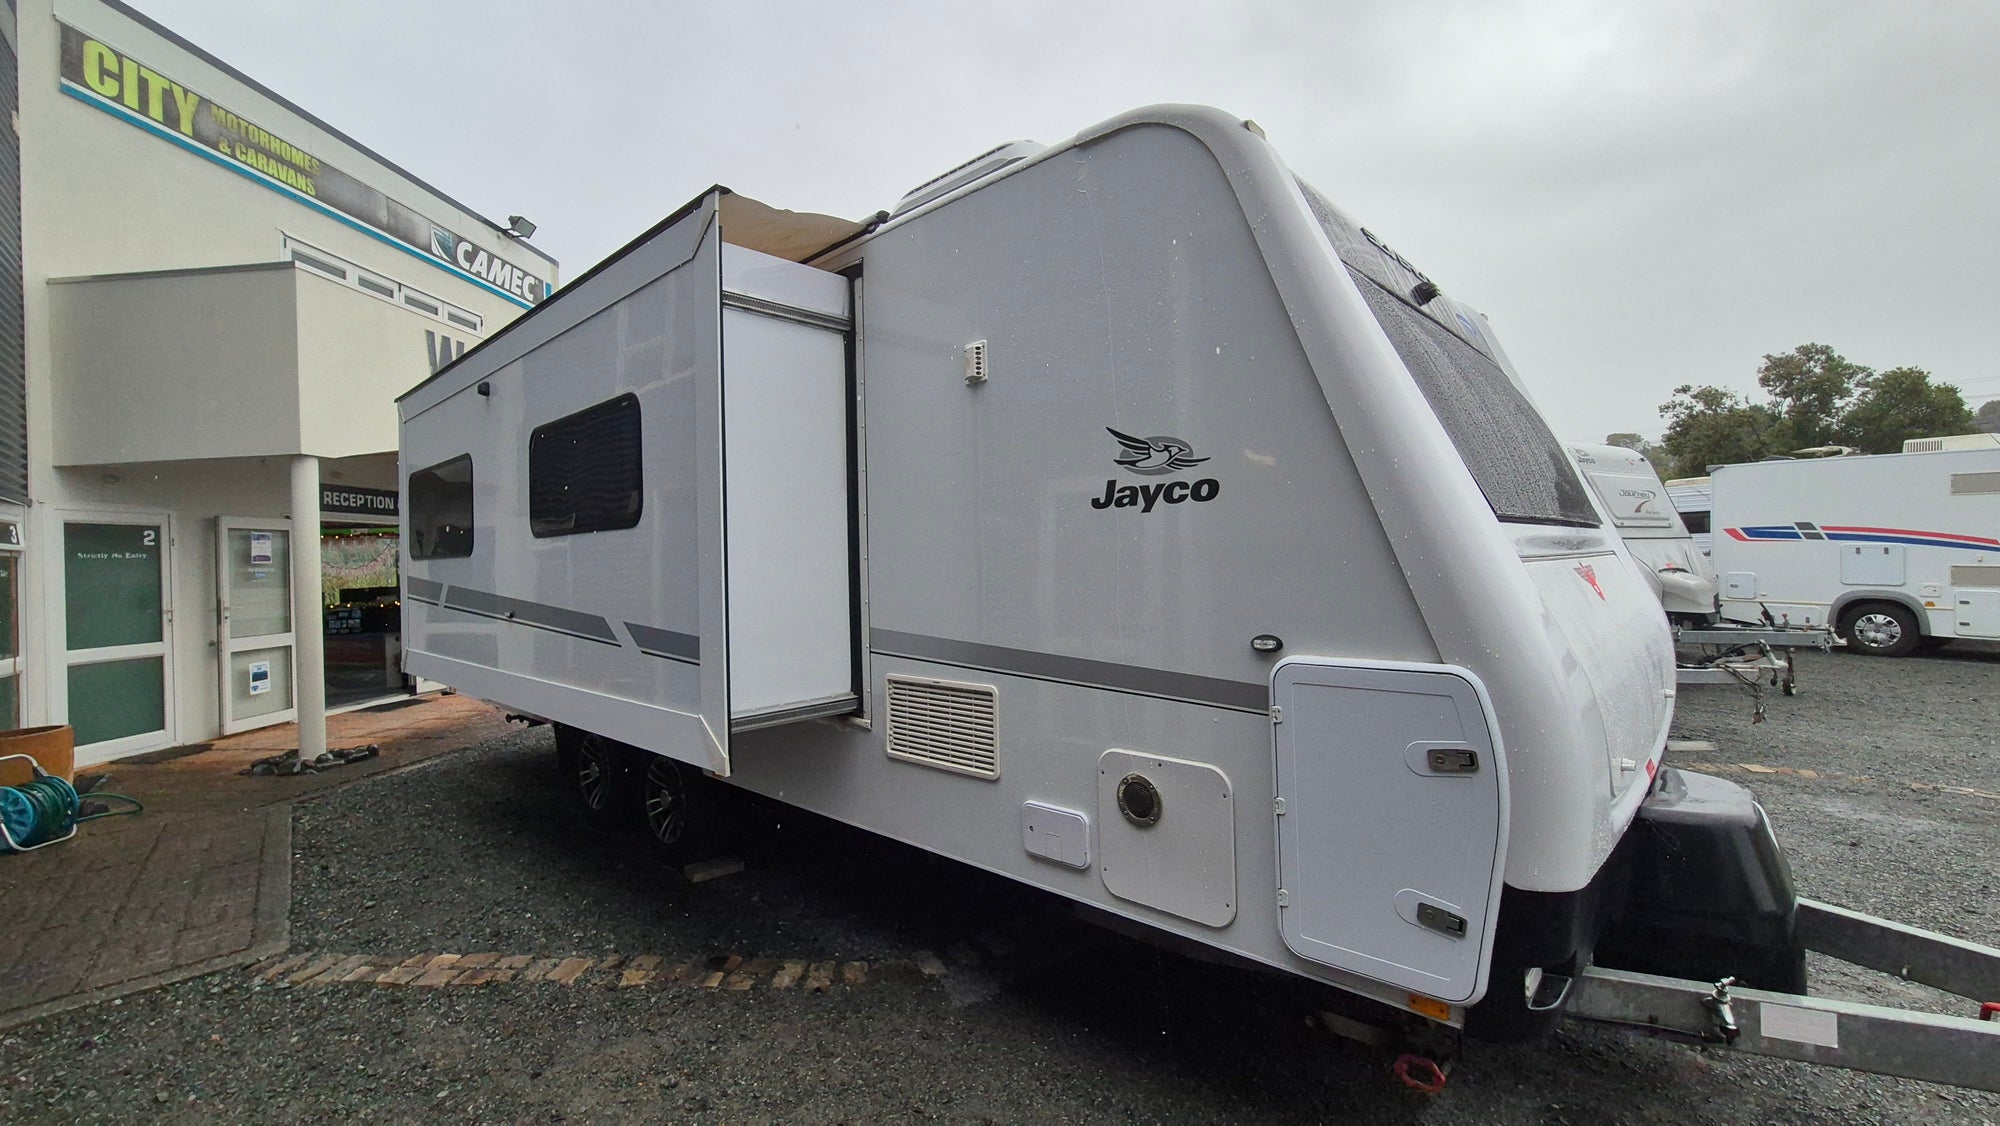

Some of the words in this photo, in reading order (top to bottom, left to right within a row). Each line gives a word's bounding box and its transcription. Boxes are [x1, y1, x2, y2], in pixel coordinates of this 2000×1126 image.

[82, 40, 199, 137] CITY
[211, 103, 320, 176] MOTORHOMES
[218, 136, 231, 155] &
[235, 142, 316, 196] CARAVANS
[457, 241, 535, 301] CAMEC
[323, 491, 395, 509] RECEPTION
[1091, 478, 1220, 513] Jayco
[9, 526, 18, 543] 3
[143, 530, 155, 545] 2
[77, 552, 109, 560] Strictly
